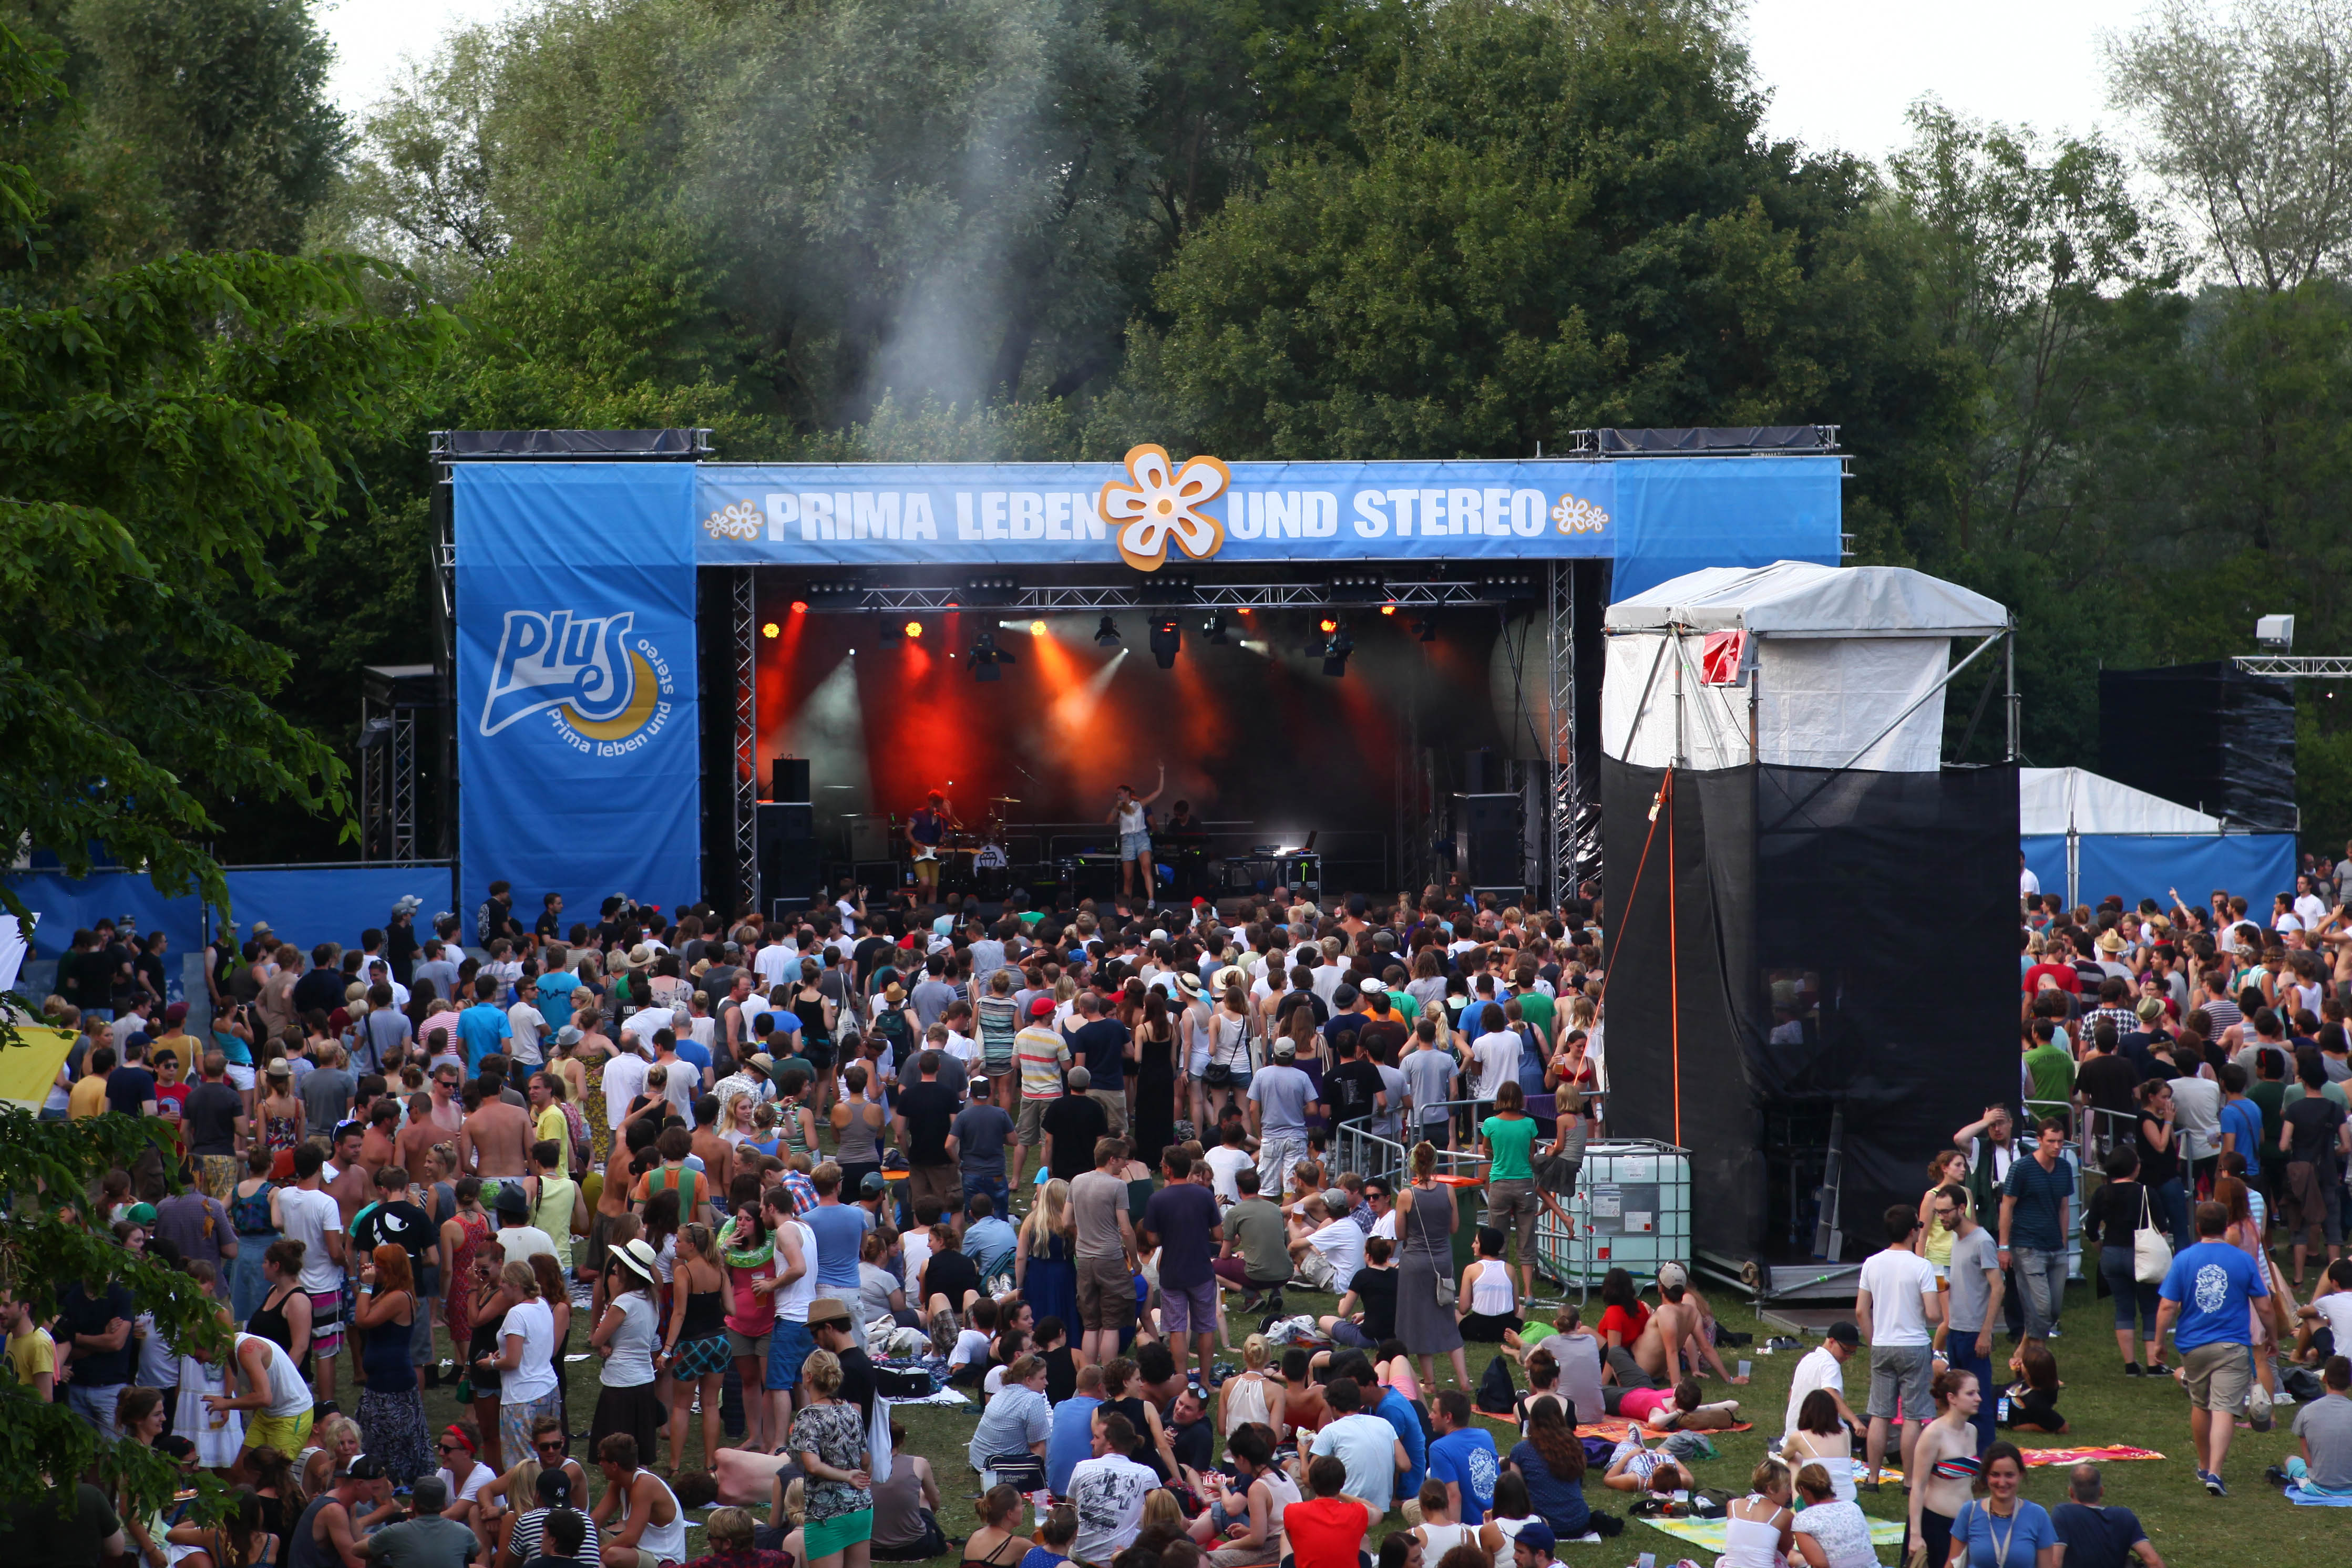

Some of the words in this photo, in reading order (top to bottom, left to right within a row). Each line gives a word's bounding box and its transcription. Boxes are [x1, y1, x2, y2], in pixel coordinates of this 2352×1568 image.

[765, 491, 938, 542] PRIMA
[956, 491, 1106, 540] LEBEN
[1227, 491, 1338, 540] UND
[1353, 488, 1547, 538] STEREO
[480, 610, 635, 737] Plus
[637, 638, 674, 695] stereo
[547, 707, 591, 754] Prima
[646, 701, 672, 735] und
[597, 735, 649, 757] leben
[622, 1005, 638, 1015] NIRV
